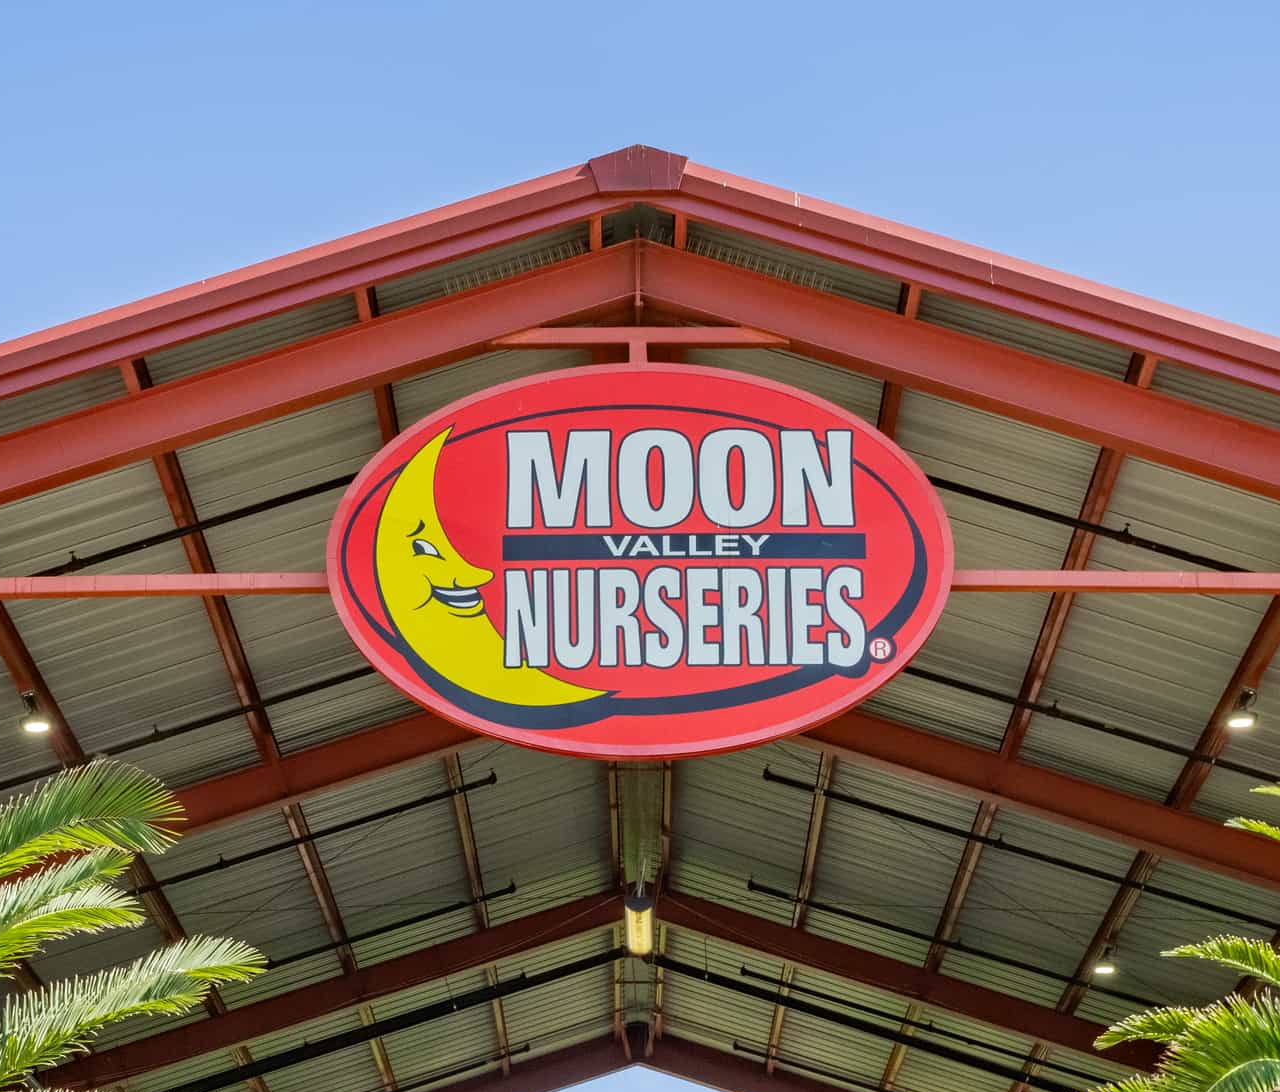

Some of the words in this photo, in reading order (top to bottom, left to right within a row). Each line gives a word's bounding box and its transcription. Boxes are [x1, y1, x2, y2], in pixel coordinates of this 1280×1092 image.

[506, 428, 855, 528] MOON
[605, 534, 771, 556] VALLEY
[504, 567, 866, 669] NURSERIES
